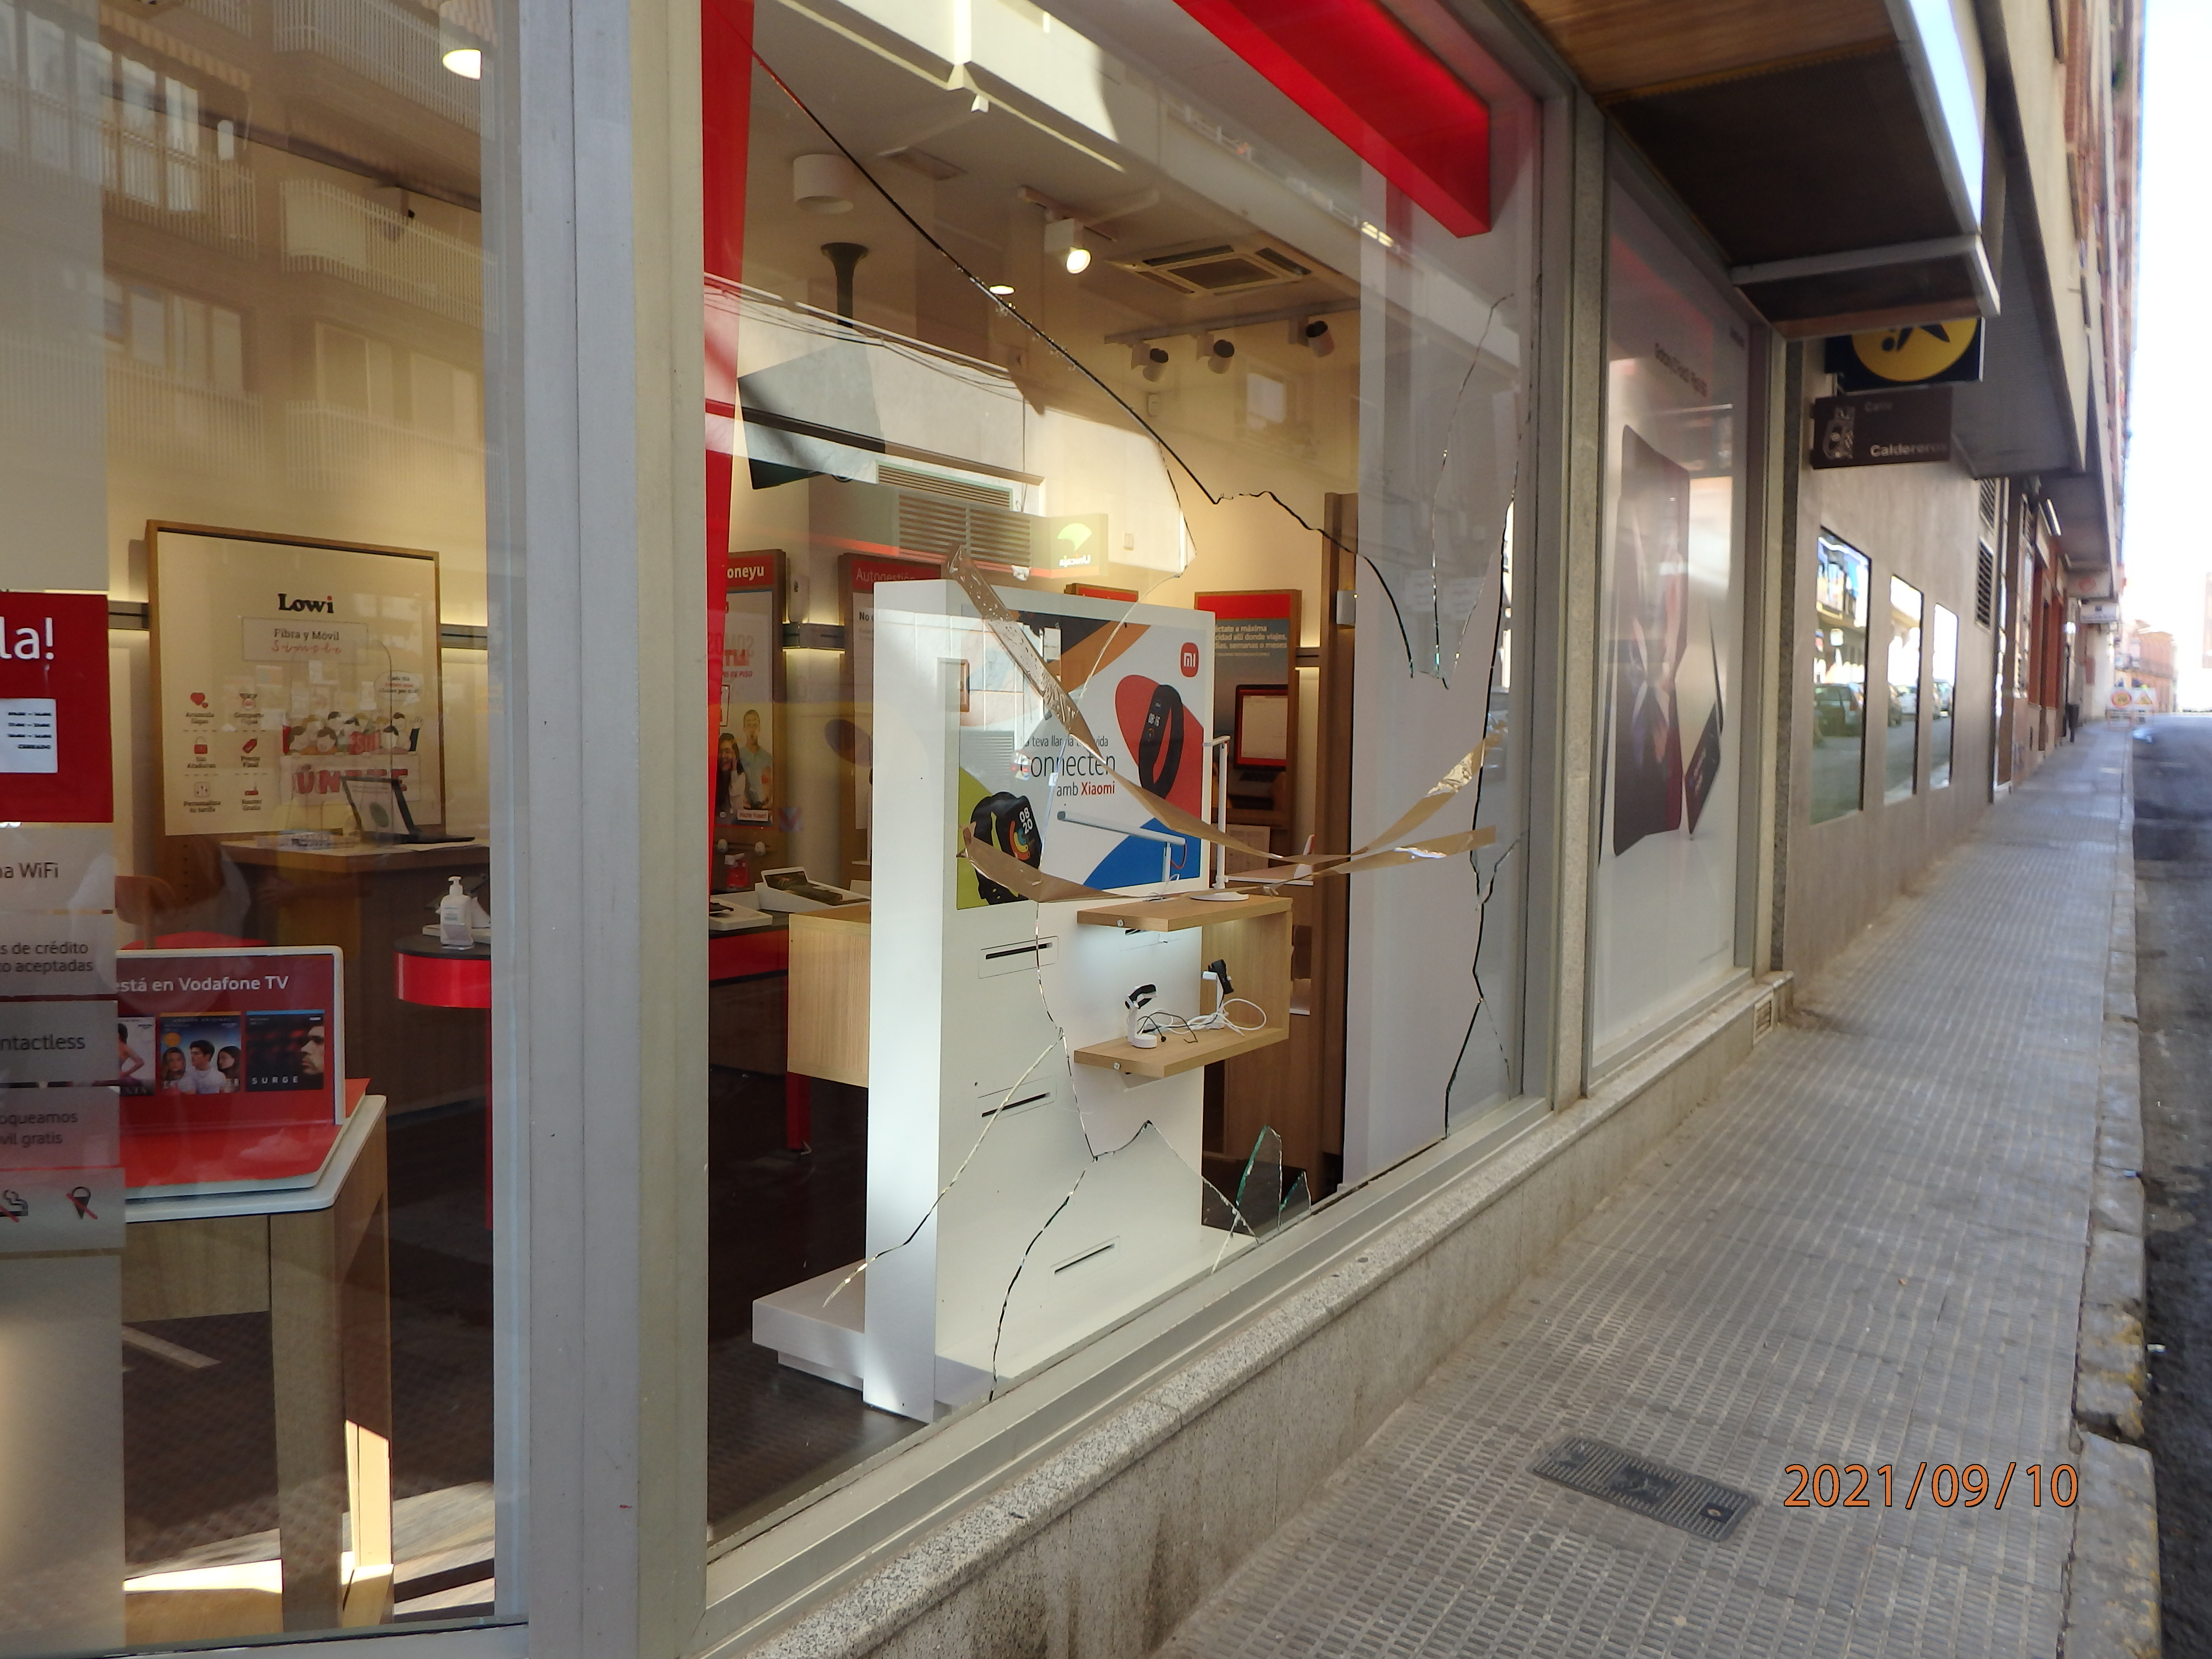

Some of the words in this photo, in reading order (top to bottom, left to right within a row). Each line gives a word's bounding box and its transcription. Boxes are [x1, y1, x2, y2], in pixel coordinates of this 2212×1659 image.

[856, 568, 916, 581] Autogestió
[277, 593, 334, 613] Lowi
[859, 612, 870, 621] No
[274, 628, 301, 639] Fibra
[303, 632, 309, 642] y
[312, 631, 339, 641] Móvil
[1032, 736, 1049, 747] teva
[1020, 753, 1116, 778] onnecten
[297, 763, 408, 794] ÚNE
[1057, 781, 1079, 796] amb
[1081, 781, 1115, 795] Xiaomi
[1019, 807, 1030, 823] 08
[1022, 818, 1033, 835] 20
[19, 862, 59, 878] WiFi
[12, 942, 31, 954] de
[36, 940, 88, 954] crédito
[16, 960, 94, 974] aceptadas
[152, 979, 174, 992] en
[178, 976, 261, 992] Vodafone
[264, 976, 289, 990] TV
[252, 1075, 299, 1085] SURGE
[22, 1132, 63, 1148] gratis
